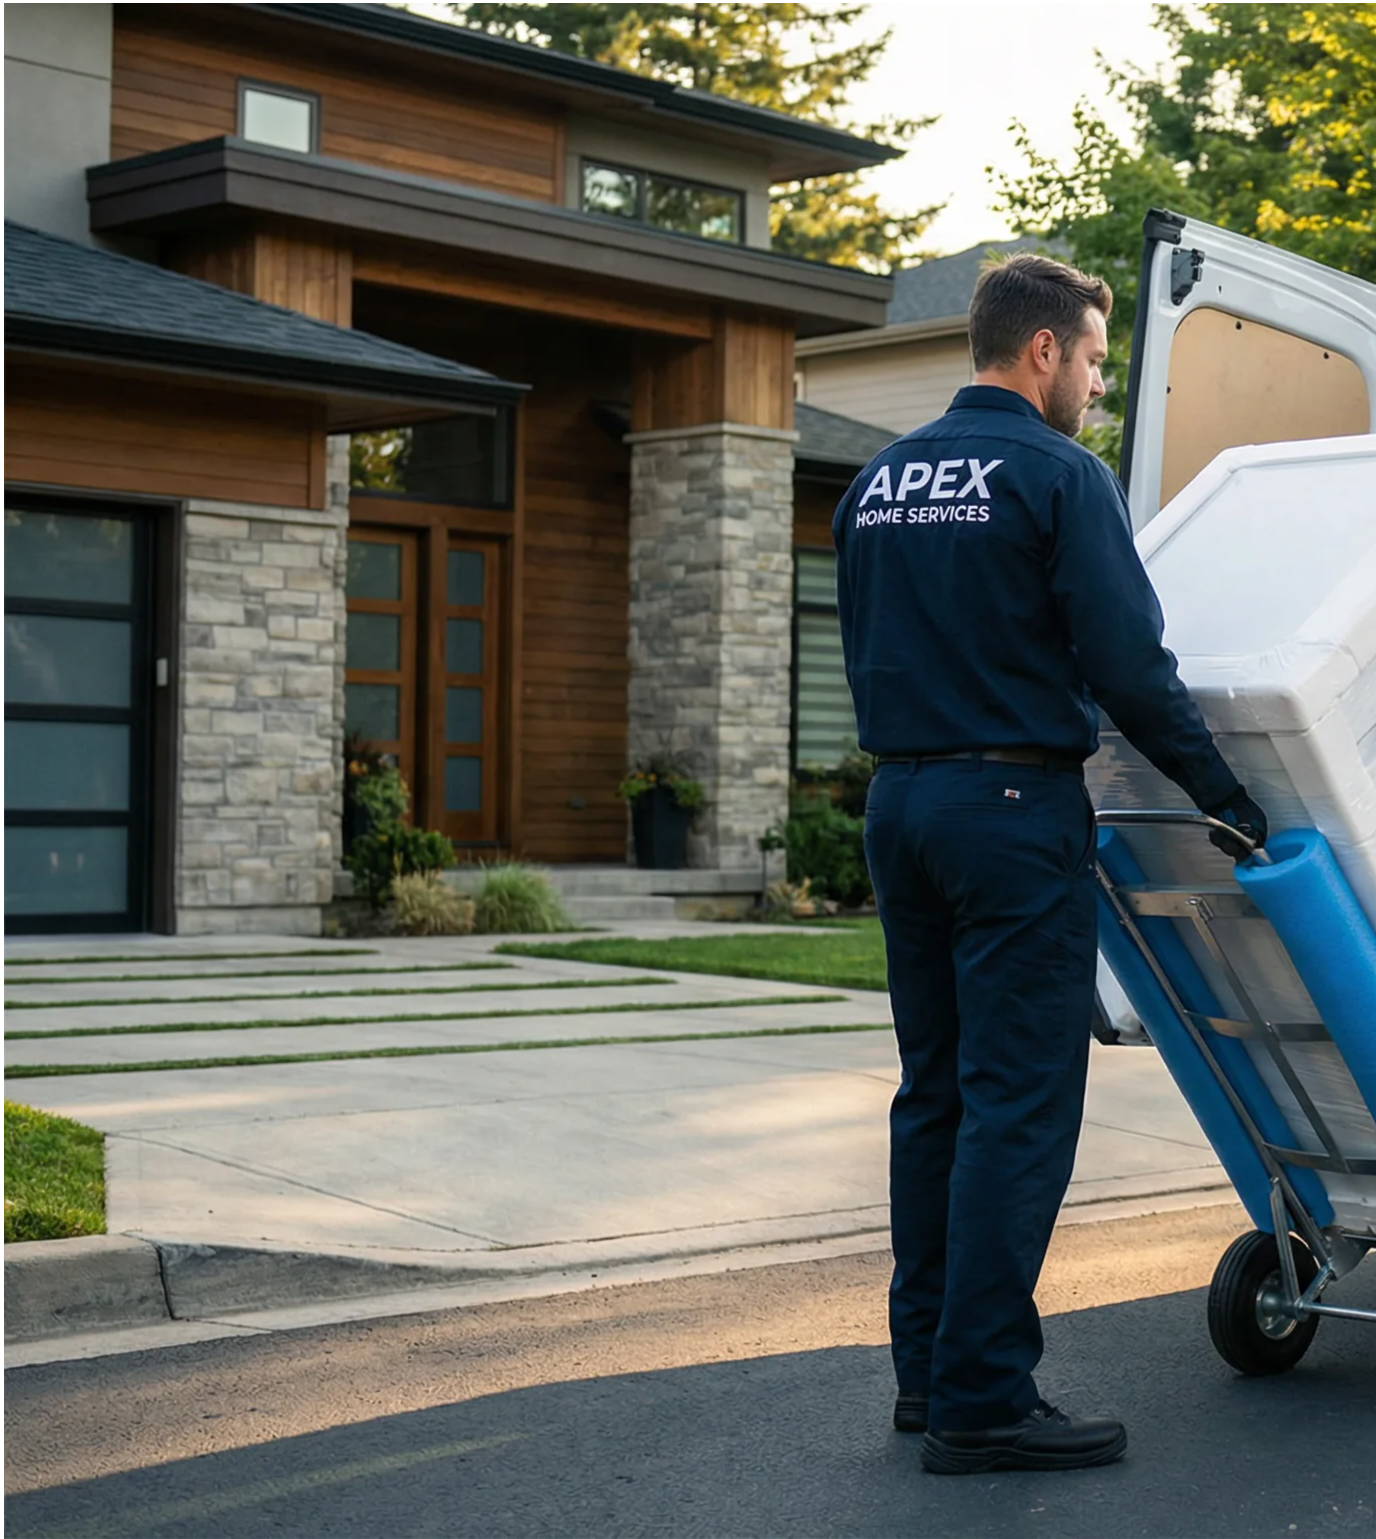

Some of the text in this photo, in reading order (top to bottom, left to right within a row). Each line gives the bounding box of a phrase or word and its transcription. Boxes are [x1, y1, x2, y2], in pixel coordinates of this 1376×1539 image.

[858, 458, 1005, 508] APEX
[856, 504, 990, 529] HOME SERVICES
